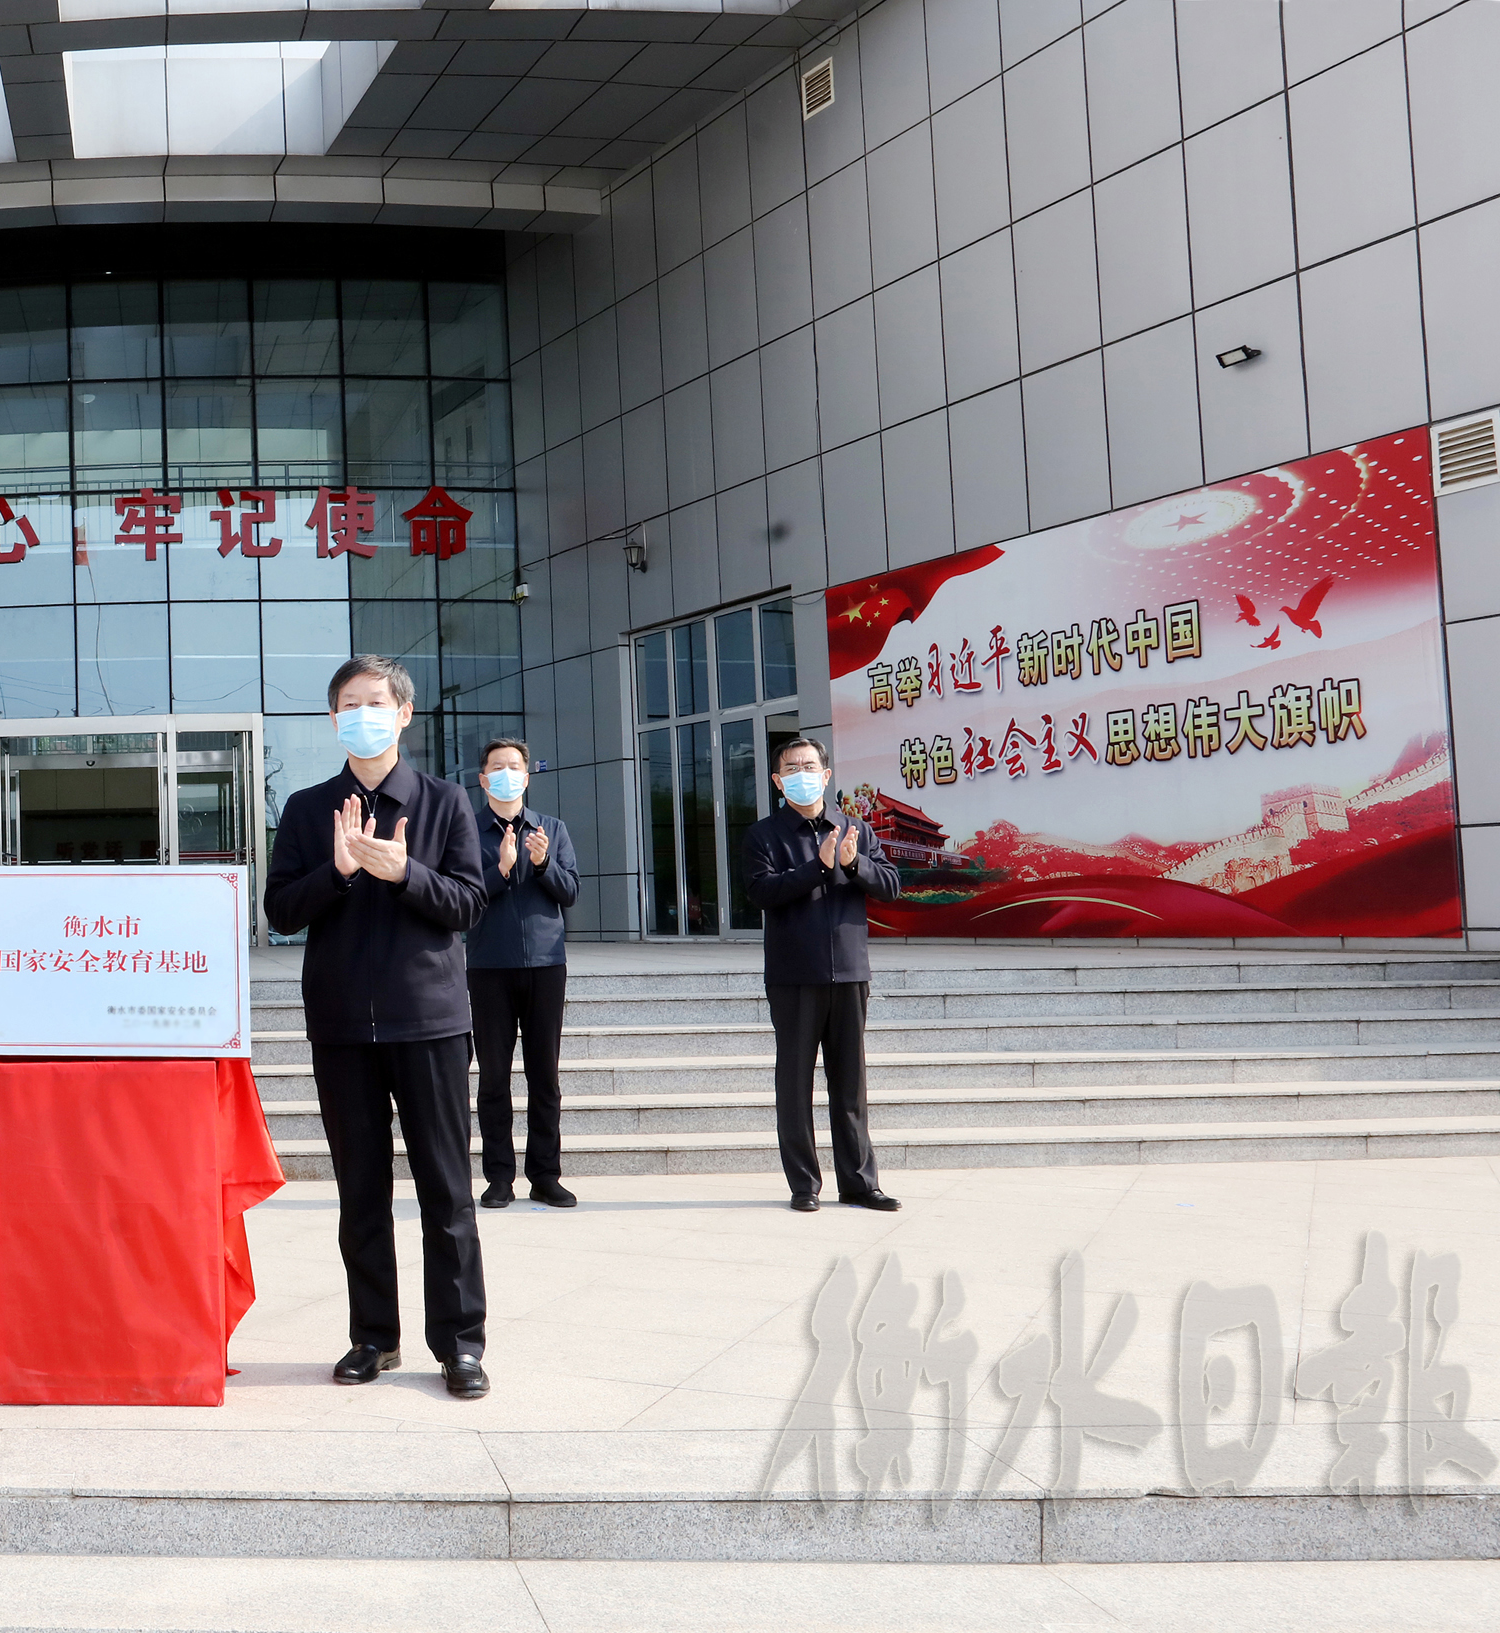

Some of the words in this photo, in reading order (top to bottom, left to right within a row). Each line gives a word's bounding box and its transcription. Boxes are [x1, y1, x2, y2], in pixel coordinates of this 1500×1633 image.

[113, 485, 475, 561] 牢记使命
[867, 599, 1202, 713] 高举习近平新时代中国
[899, 678, 1368, 790] 特色社会主义思想伟大旗帜
[63, 915, 141, 938] 衡水市
